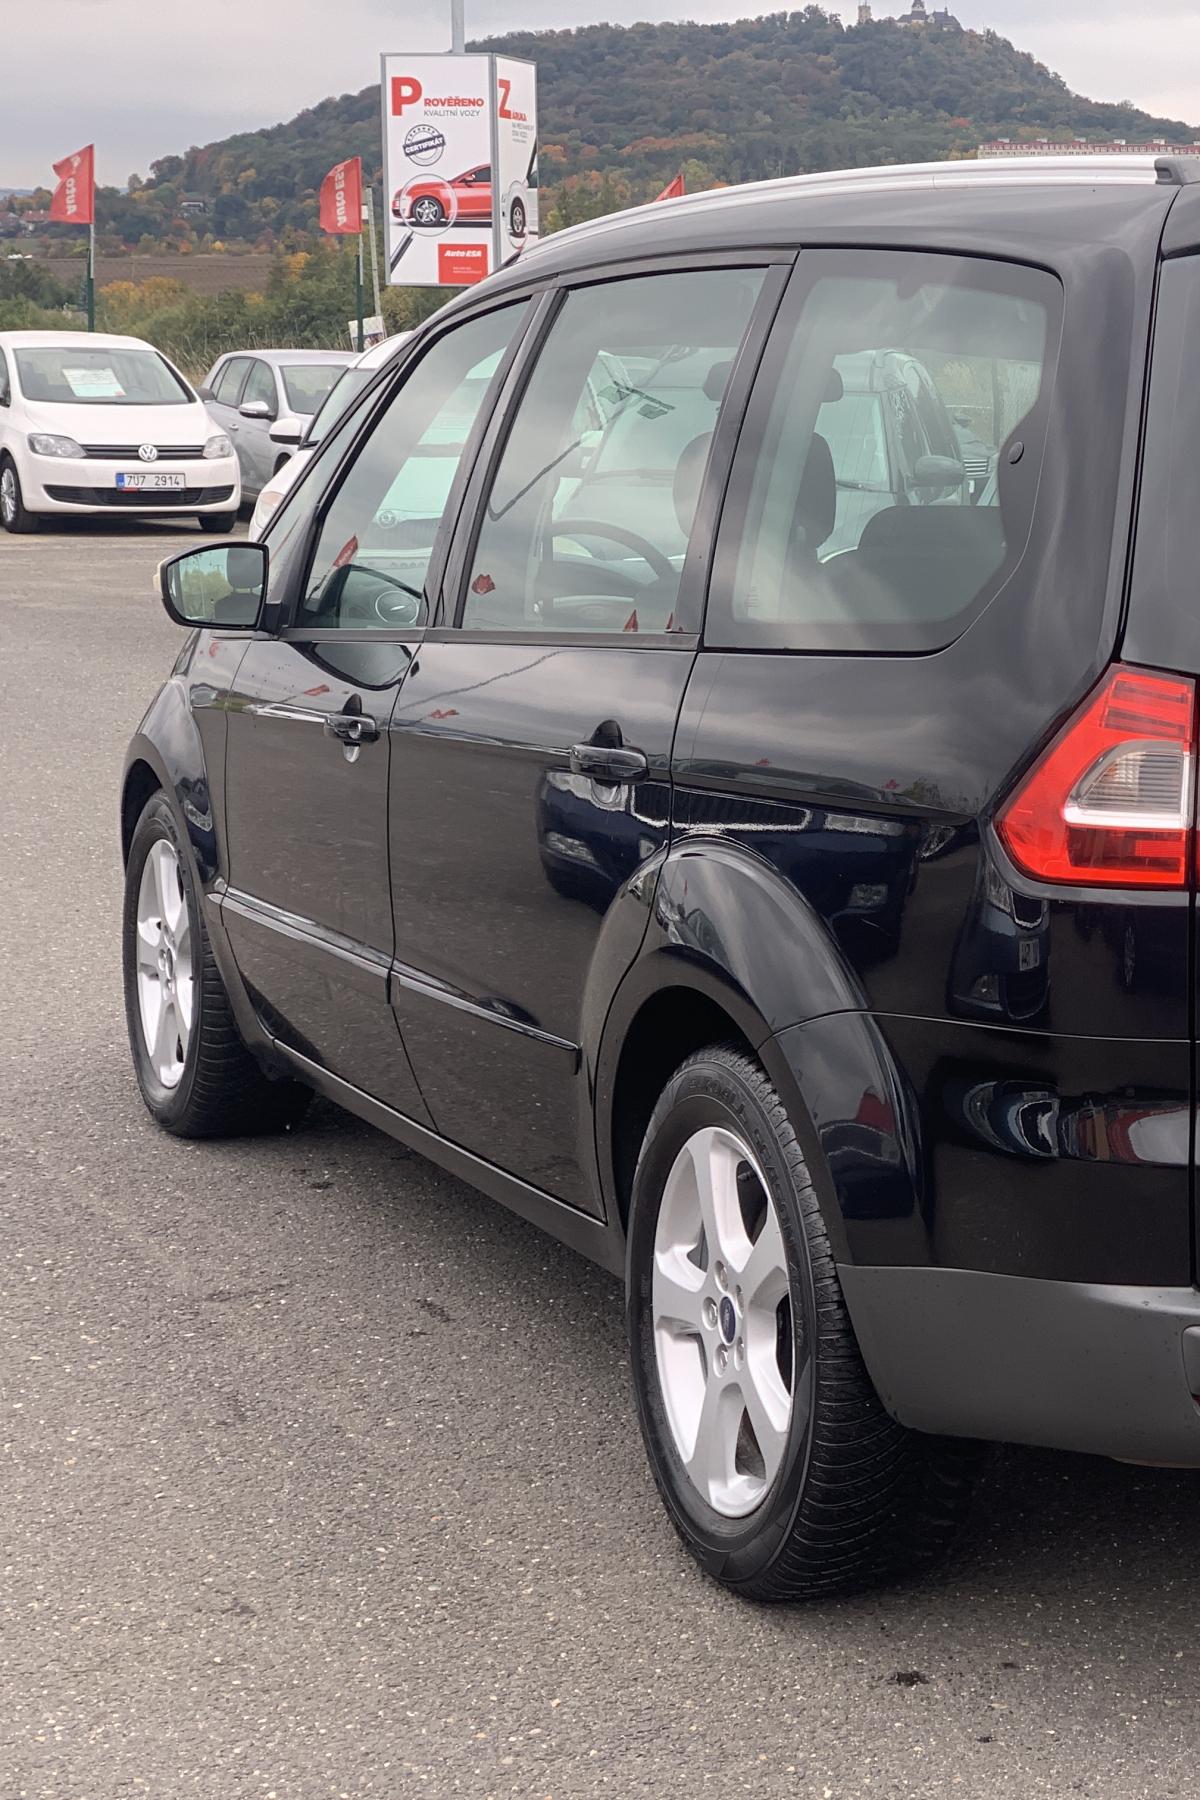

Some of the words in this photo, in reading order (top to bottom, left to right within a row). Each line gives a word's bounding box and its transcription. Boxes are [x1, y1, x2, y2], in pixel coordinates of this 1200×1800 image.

[424, 108, 458, 117] KVALITNÍ
[460, 109, 480, 117] VOZY
[335, 191, 347, 227] Auto
[126, 475, 146, 486] 7U7
[154, 475, 180, 486] 2914
